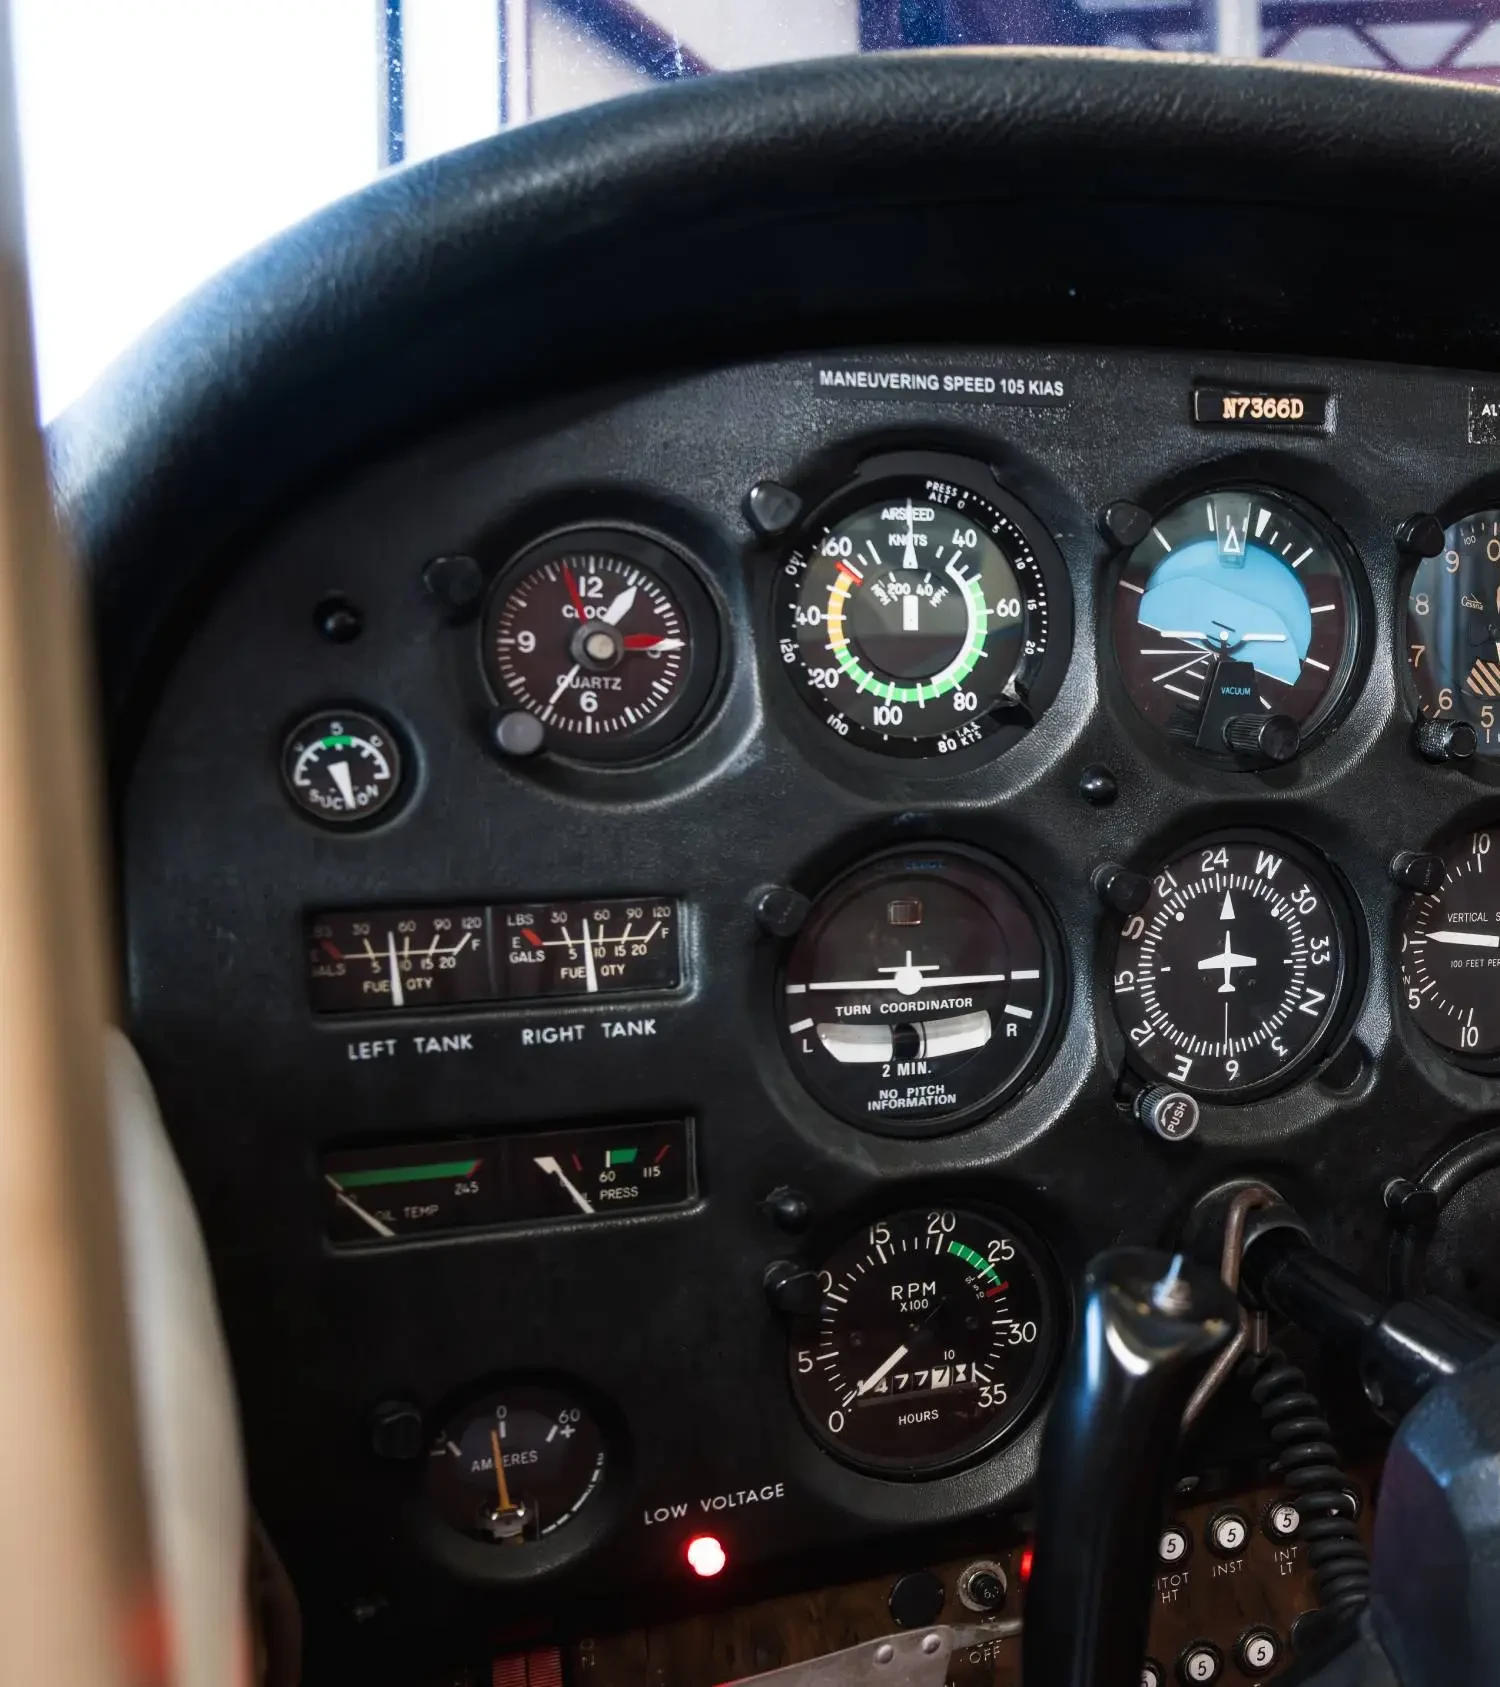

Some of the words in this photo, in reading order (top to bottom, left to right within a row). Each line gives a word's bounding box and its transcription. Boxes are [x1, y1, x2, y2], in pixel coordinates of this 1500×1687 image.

[819, 369, 940, 391] MANEUVERING
[942, 375, 996, 393] SPEED
[999, 380, 1025, 395] 105
[1028, 379, 1065, 396] KIAS
[1221, 397, 1305, 421] N7366D
[925, 480, 958, 497] PRESS
[821, 536, 853, 557] 160
[952, 529, 977, 548] 40
[1444, 550, 1460, 573] 9
[578, 575, 604, 599] 12
[996, 599, 1021, 618] 60
[1415, 592, 1430, 616] 8
[516, 631, 536, 653] 9
[1410, 644, 1426, 668] 7
[1220, 686, 1251, 696] VACUUM
[1438, 688, 1453, 711] 6
[580, 691, 599, 713] 6
[953, 692, 978, 711] 80
[873, 706, 903, 726] 100
[1480, 706, 1494, 729] 5
[938, 738, 957, 754] 80
[1472, 832, 1491, 855] 10
[1201, 847, 1229, 872] 24
[1255, 850, 1283, 880] W
[1153, 869, 1179, 898] 21
[1291, 883, 1317, 914] 30
[506, 913, 535, 926] LBS
[550, 912, 568, 924] 30
[593, 909, 611, 921] 60
[626, 907, 644, 919] 90
[652, 906, 671, 918] 120
[1447, 911, 1489, 924] VERTICAL
[433, 918, 452, 930] 90
[461, 916, 483, 929] 120
[508, 950, 546, 964] GALS
[614, 945, 627, 957] 15
[631, 944, 648, 956] 20
[1310, 935, 1330, 966] 33
[438, 957, 457, 969] 20
[600, 964, 627, 976] QTY
[1450, 959, 1463, 969] 100
[1465, 958, 1485, 968] FEET
[406, 978, 434, 991] QTY
[1114, 970, 1135, 993] 15
[835, 1004, 872, 1017] TURN
[879, 997, 973, 1015] COORDINATOR
[1299, 987, 1326, 1016] N
[1408, 987, 1421, 1010] 5
[521, 1024, 585, 1046] RIGHT
[602, 1018, 657, 1039] TANK
[1006, 1023, 1018, 1037] R
[1130, 1020, 1156, 1047] 12
[1460, 1026, 1480, 1048] 10
[348, 1039, 398, 1061] LEFT
[413, 1034, 474, 1055] TANK
[802, 1038, 814, 1054] L
[882, 1064, 891, 1078] 2
[897, 1062, 932, 1077] MIN.
[1167, 1054, 1194, 1082] E
[879, 1088, 899, 1100] NO
[906, 1085, 946, 1097] PITCH
[867, 1094, 957, 1112] INFORMATION
[1167, 1101, 1188, 1133] PUSH
[599, 1170, 617, 1183] 60
[642, 1165, 662, 1178] 115
[599, 1185, 640, 1201] PRESS
[404, 1204, 439, 1220] TEMP
[927, 1211, 957, 1235] 20
[869, 1221, 891, 1246] 15
[987, 1239, 1015, 1263] 25
[891, 1280, 937, 1301] RPM
[900, 1298, 929, 1313] X100
[1007, 1321, 1037, 1345] 30
[798, 1350, 814, 1373] 5
[977, 1383, 1008, 1408] 35
[496, 1405, 508, 1420] 0
[558, 1407, 582, 1425] 60
[828, 1410, 845, 1433] 0
[898, 1409, 940, 1426] HOURS
[644, 1502, 689, 1526] LOW
[699, 1482, 786, 1514] VOLTAGE
[1282, 1512, 1292, 1529] 5
[1227, 1528, 1237, 1543] 5
[1166, 1537, 1177, 1554] 5
[1274, 1546, 1299, 1562] INT
[1212, 1559, 1244, 1577] INST
[1280, 1561, 1293, 1576] LT
[1161, 1589, 1179, 1604] HT
[1256, 1646, 1266, 1661] 5
[1198, 1660, 1207, 1676] 5
